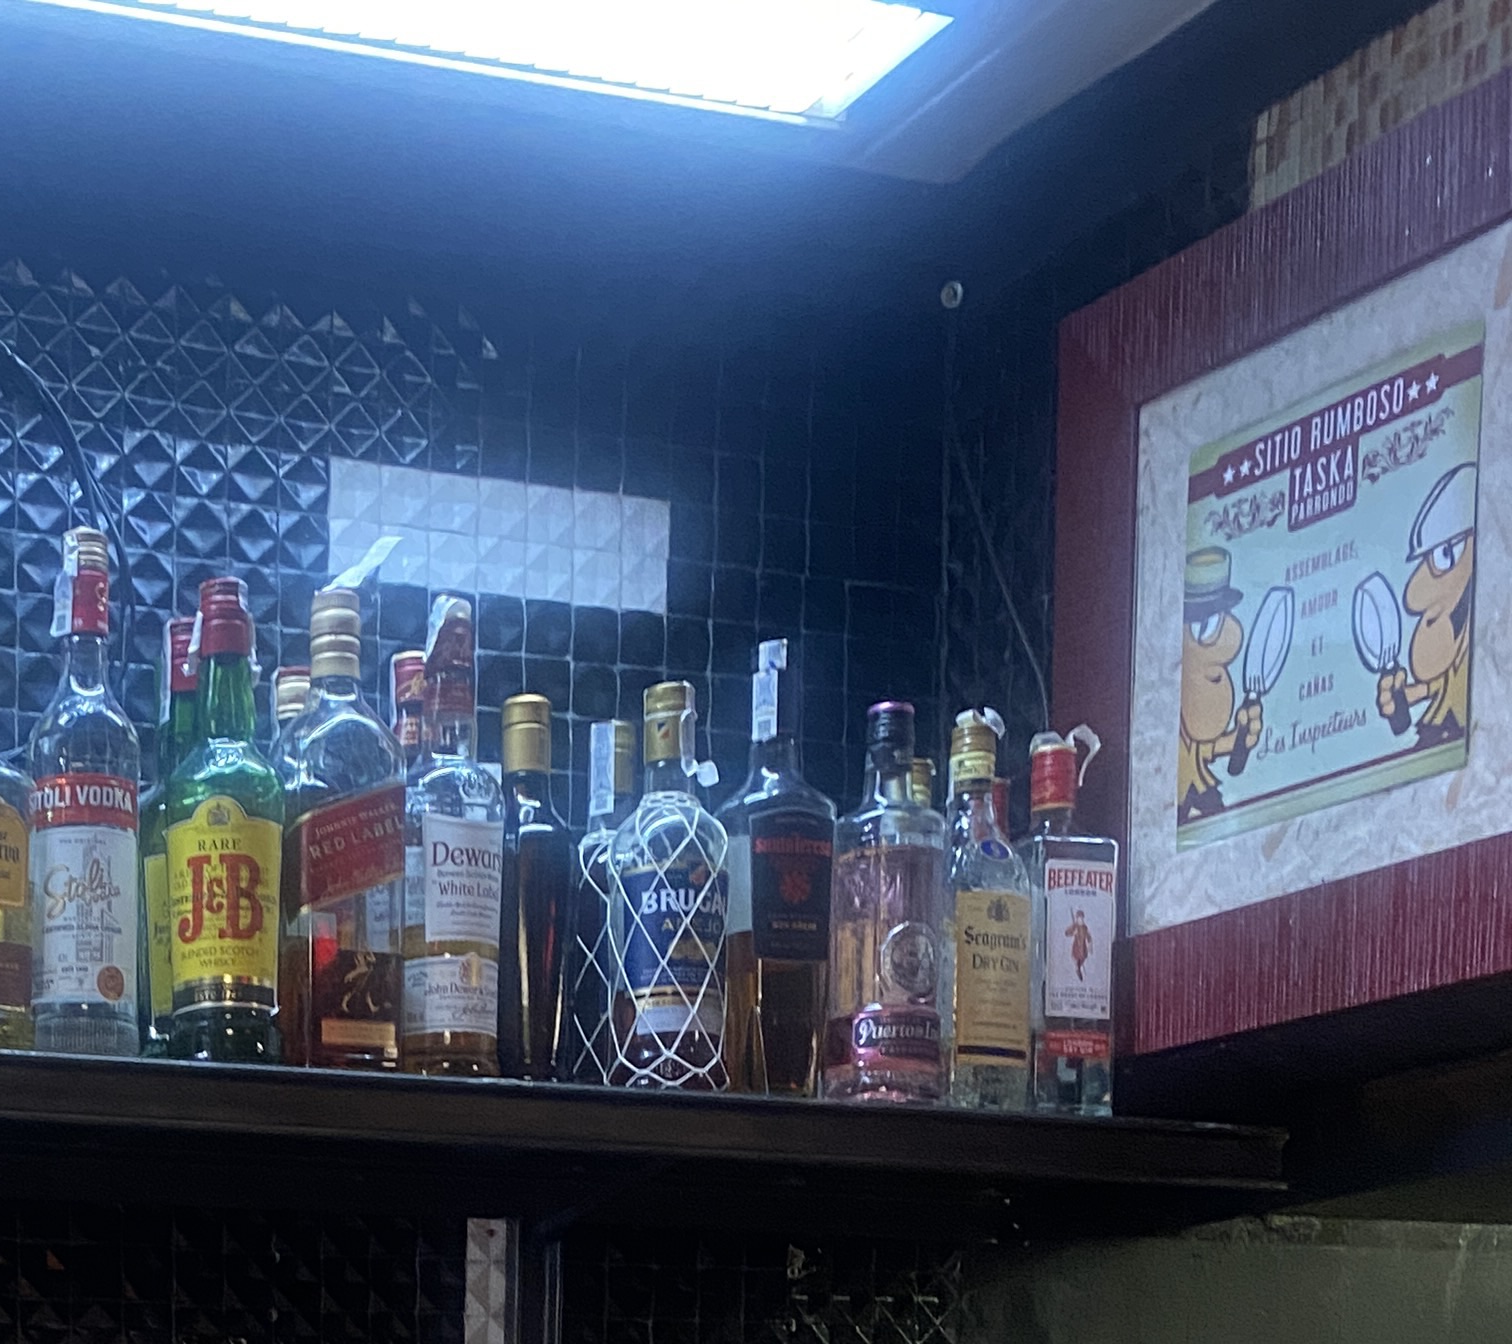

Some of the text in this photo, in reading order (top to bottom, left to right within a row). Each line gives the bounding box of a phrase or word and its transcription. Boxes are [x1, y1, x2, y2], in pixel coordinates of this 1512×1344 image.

[1254, 378, 1405, 476] SITIO RUMBOSO
[1294, 446, 1354, 498] TASKA
[29, 785, 133, 815] STOLI VODKA
[197, 838, 242, 851] RARE
[308, 815, 405, 860] RED LABEL
[1047, 868, 1114, 892] BEEFEATER
[178, 853, 264, 944] J&B
[963, 925, 1027, 951] Seagram's
[971, 952, 1020, 973] DRY GIN
